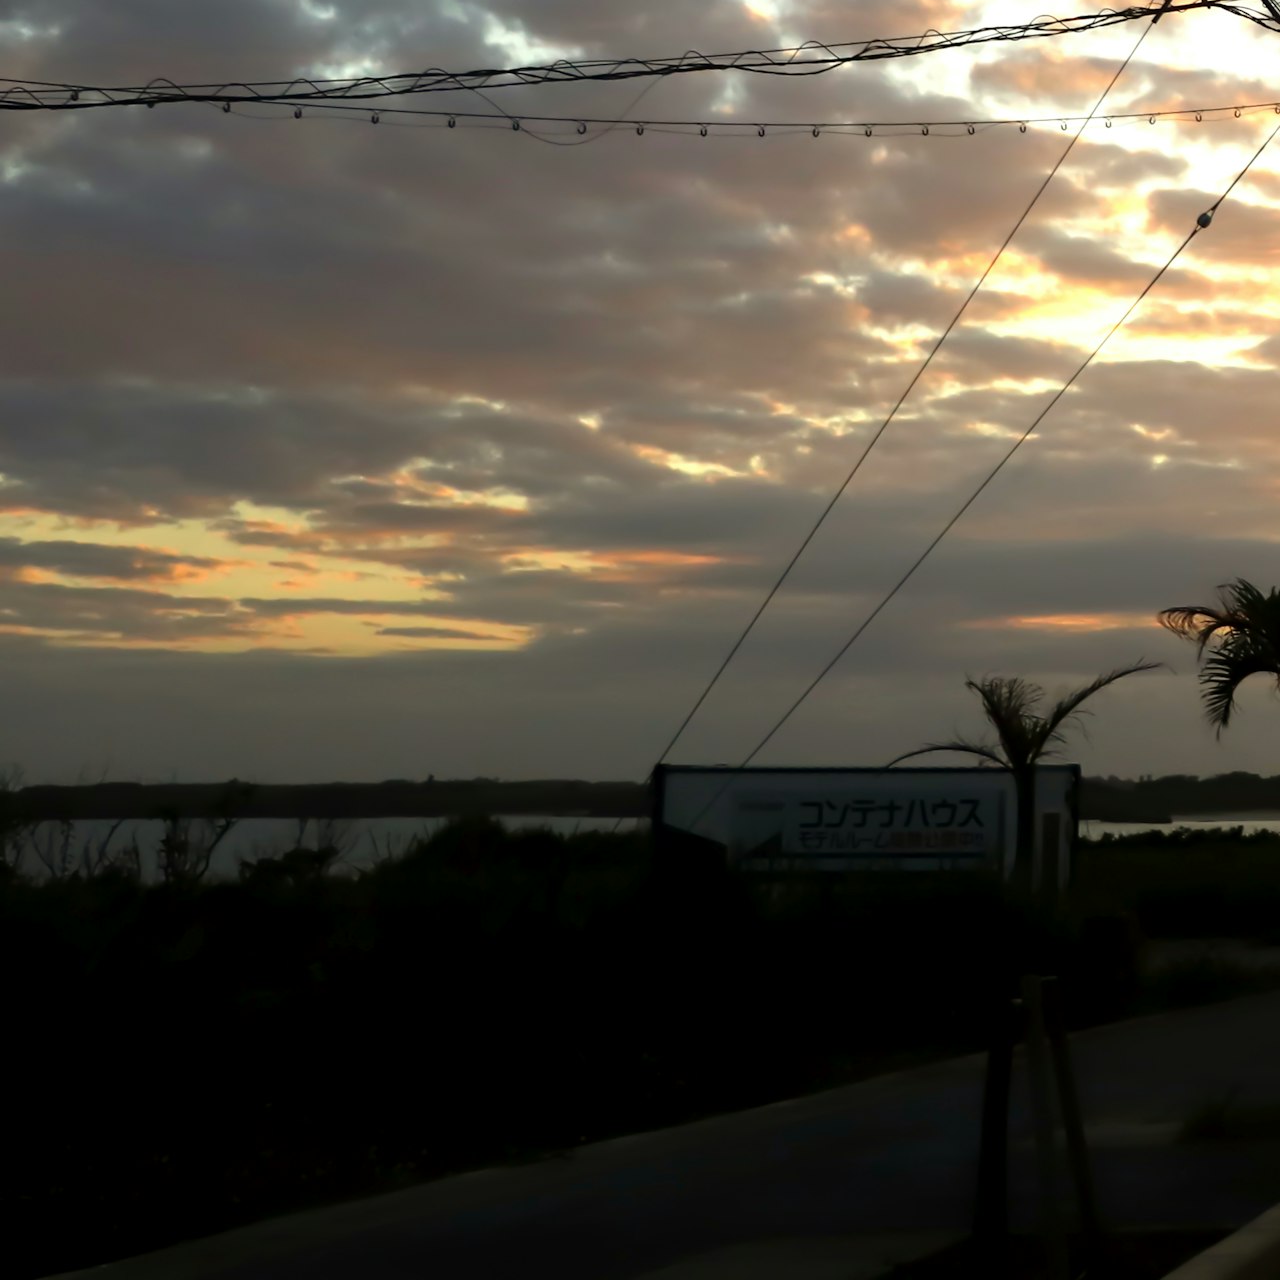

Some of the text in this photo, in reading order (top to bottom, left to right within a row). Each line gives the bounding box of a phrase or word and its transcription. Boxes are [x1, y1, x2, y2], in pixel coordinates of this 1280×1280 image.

[799, 799, 984, 828] コンテナハウス
